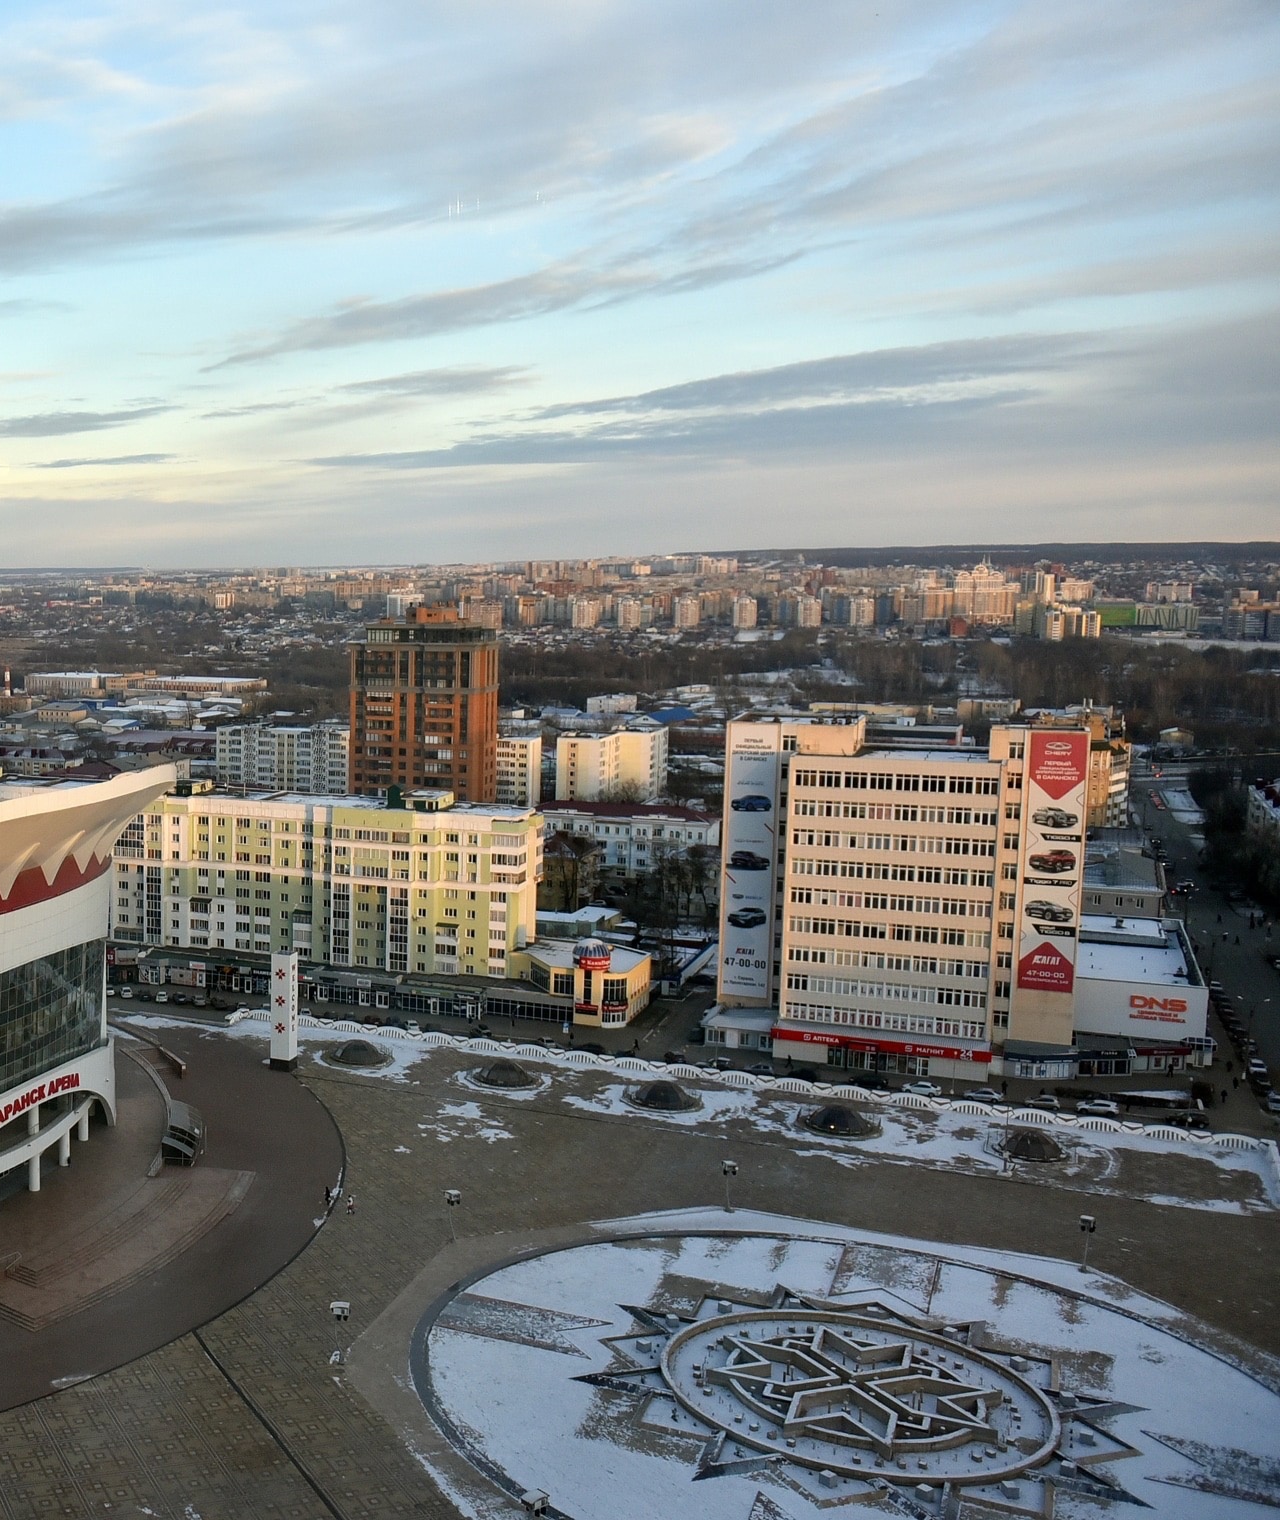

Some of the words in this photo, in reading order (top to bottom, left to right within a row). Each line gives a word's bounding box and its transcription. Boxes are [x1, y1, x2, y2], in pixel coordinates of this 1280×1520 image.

[724, 957, 766, 969] 47-00-00
[1026, 970, 1065, 978] 47-00-00
[1130, 995, 1188, 1012] DNS
[812, 1035, 840, 1044] АПТЕКА
[916, 1046, 945, 1055] МАГНИТ
[960, 1049, 973, 1057] 24
[47, 1072, 80, 1097] АРЕНА
